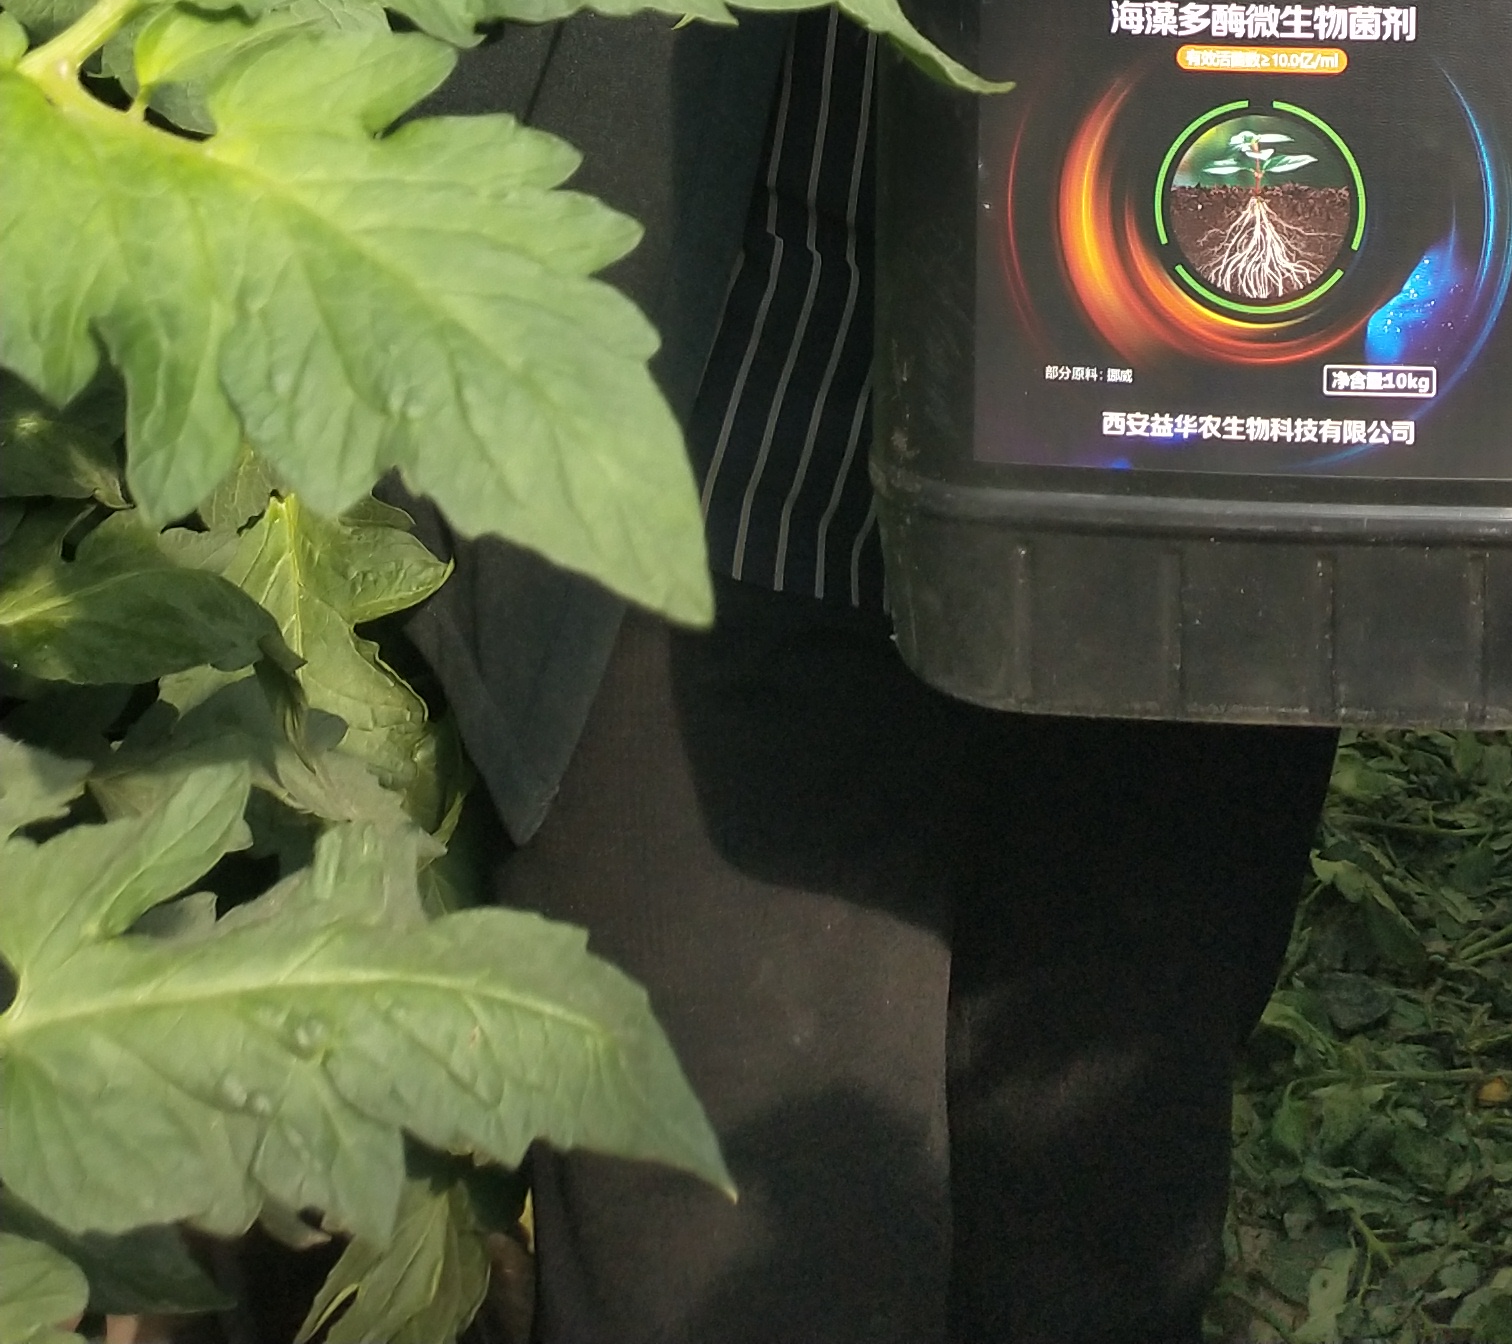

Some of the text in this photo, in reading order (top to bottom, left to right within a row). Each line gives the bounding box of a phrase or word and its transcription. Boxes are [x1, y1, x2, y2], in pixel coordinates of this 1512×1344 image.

[1110, 0, 1417, 42] 海藻多酶微生物菌剂
[1102, 411, 1415, 445] 西安益华农生物科技有限公司
